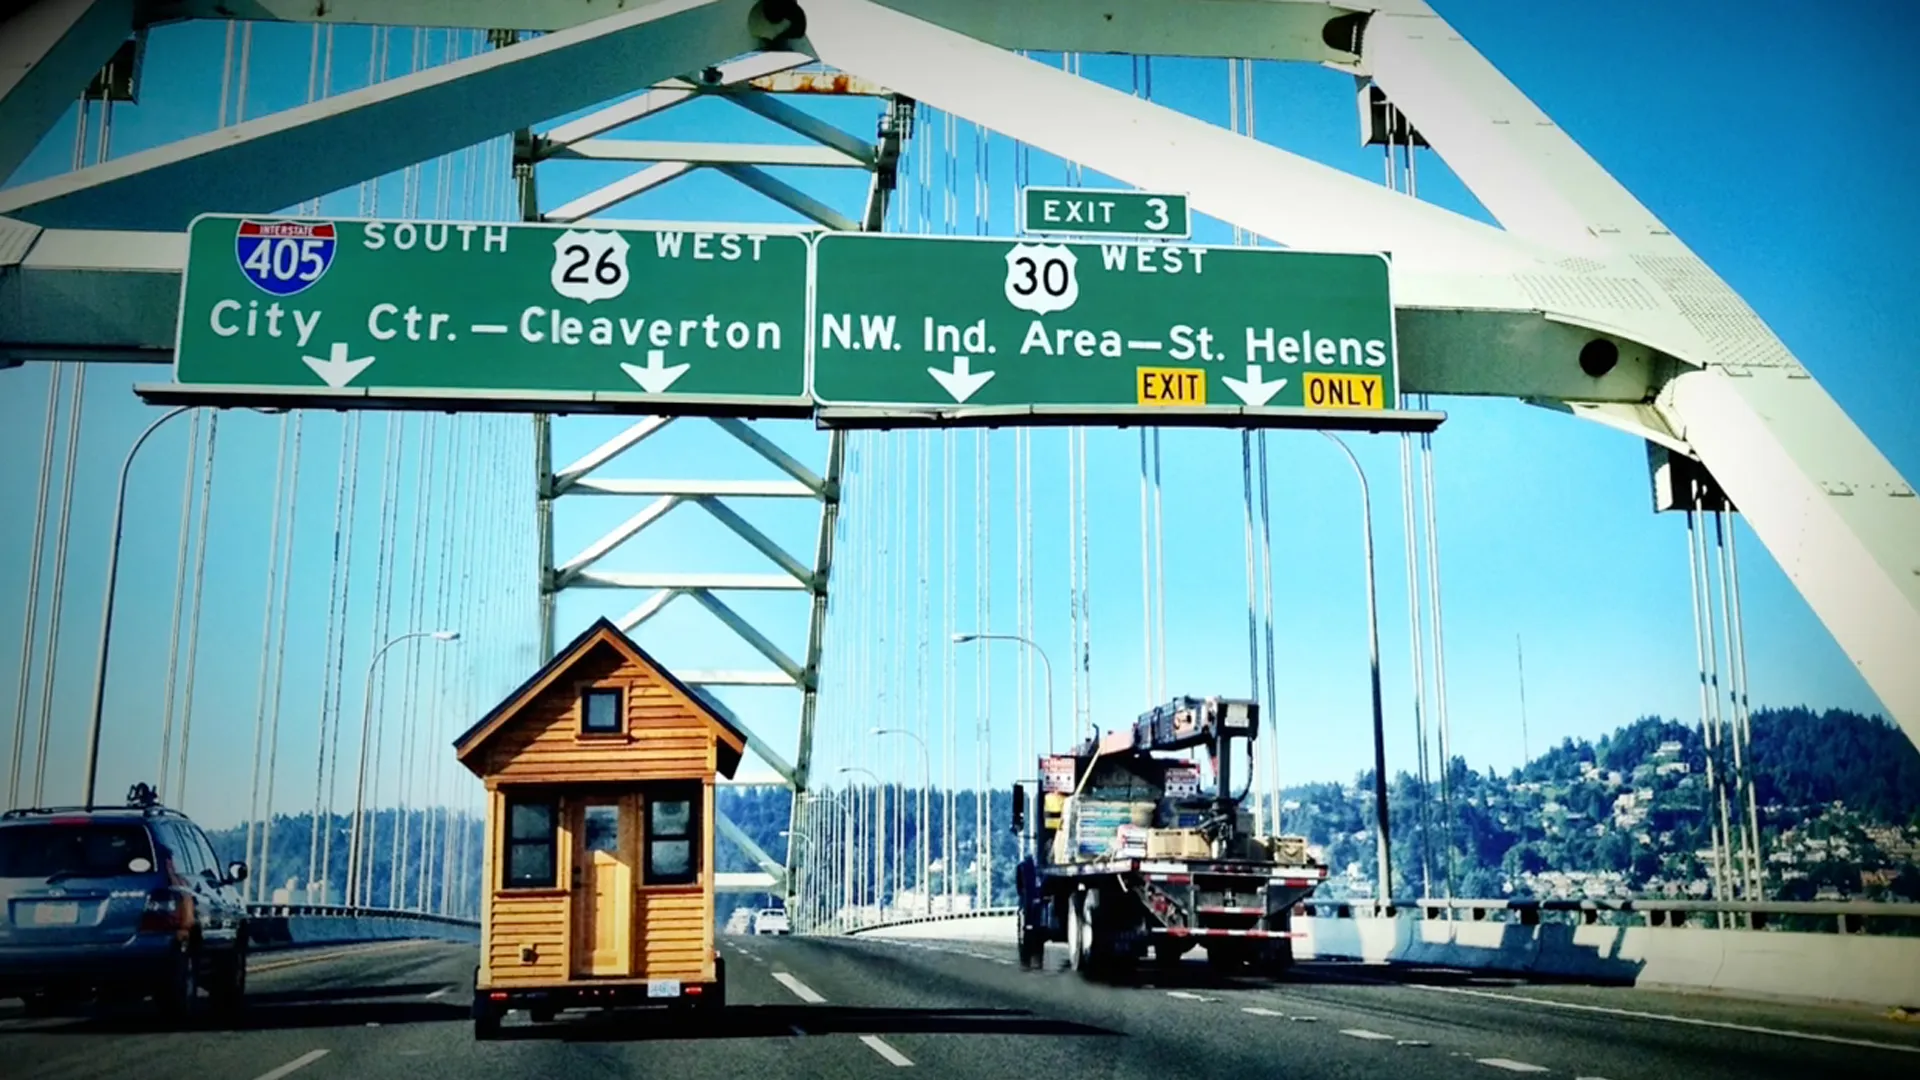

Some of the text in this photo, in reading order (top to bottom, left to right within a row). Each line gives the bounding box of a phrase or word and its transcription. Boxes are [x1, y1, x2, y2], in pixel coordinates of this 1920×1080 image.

[260, 225, 314, 236] INTERSTATE
[1043, 198, 1169, 231] EXIT 3
[363, 222, 508, 253] SOUTH
[655, 231, 768, 261] WEST
[244, 238, 324, 281] 405
[562, 244, 622, 285] 26
[1101, 244, 1208, 274] WEST
[1013, 257, 1069, 297] 30
[210, 299, 322, 347] City
[367, 303, 457, 341] Ctr.
[519, 306, 781, 350] Cleaverton
[821, 313, 901, 351] N.W.
[924, 317, 997, 354] Ind.
[1246, 327, 1386, 367] Helens
[1143, 373, 1199, 400] EXIT
[1309, 378, 1375, 406] ONLY
